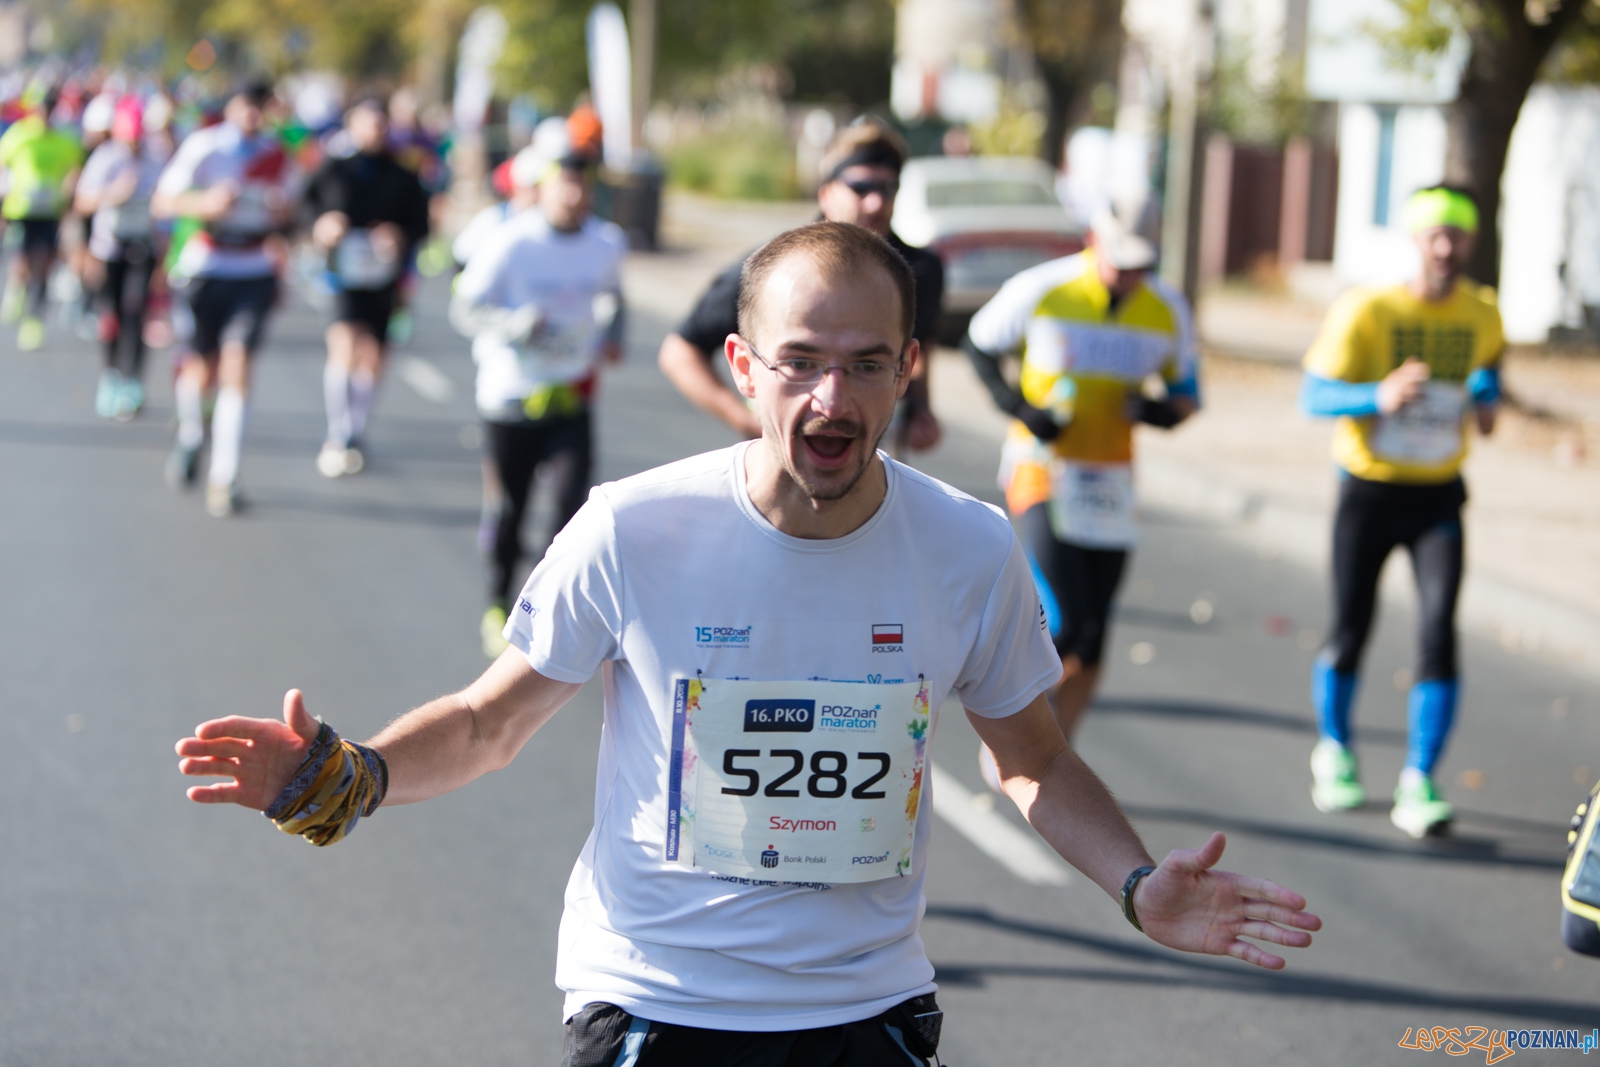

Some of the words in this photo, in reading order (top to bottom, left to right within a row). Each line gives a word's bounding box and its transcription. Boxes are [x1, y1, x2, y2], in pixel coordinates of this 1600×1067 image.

[695, 626, 712, 642] 15
[713, 635, 750, 643] maraton
[871, 645, 904, 653] POLSKA
[750, 708, 772, 722] 16.
[774, 708, 809, 722] PKO
[820, 717, 877, 728] maraton
[721, 749, 891, 799] 5282
[769, 815, 837, 833] Szymon
[783, 855, 803, 864] Bank
[804, 855, 827, 864] Polski
